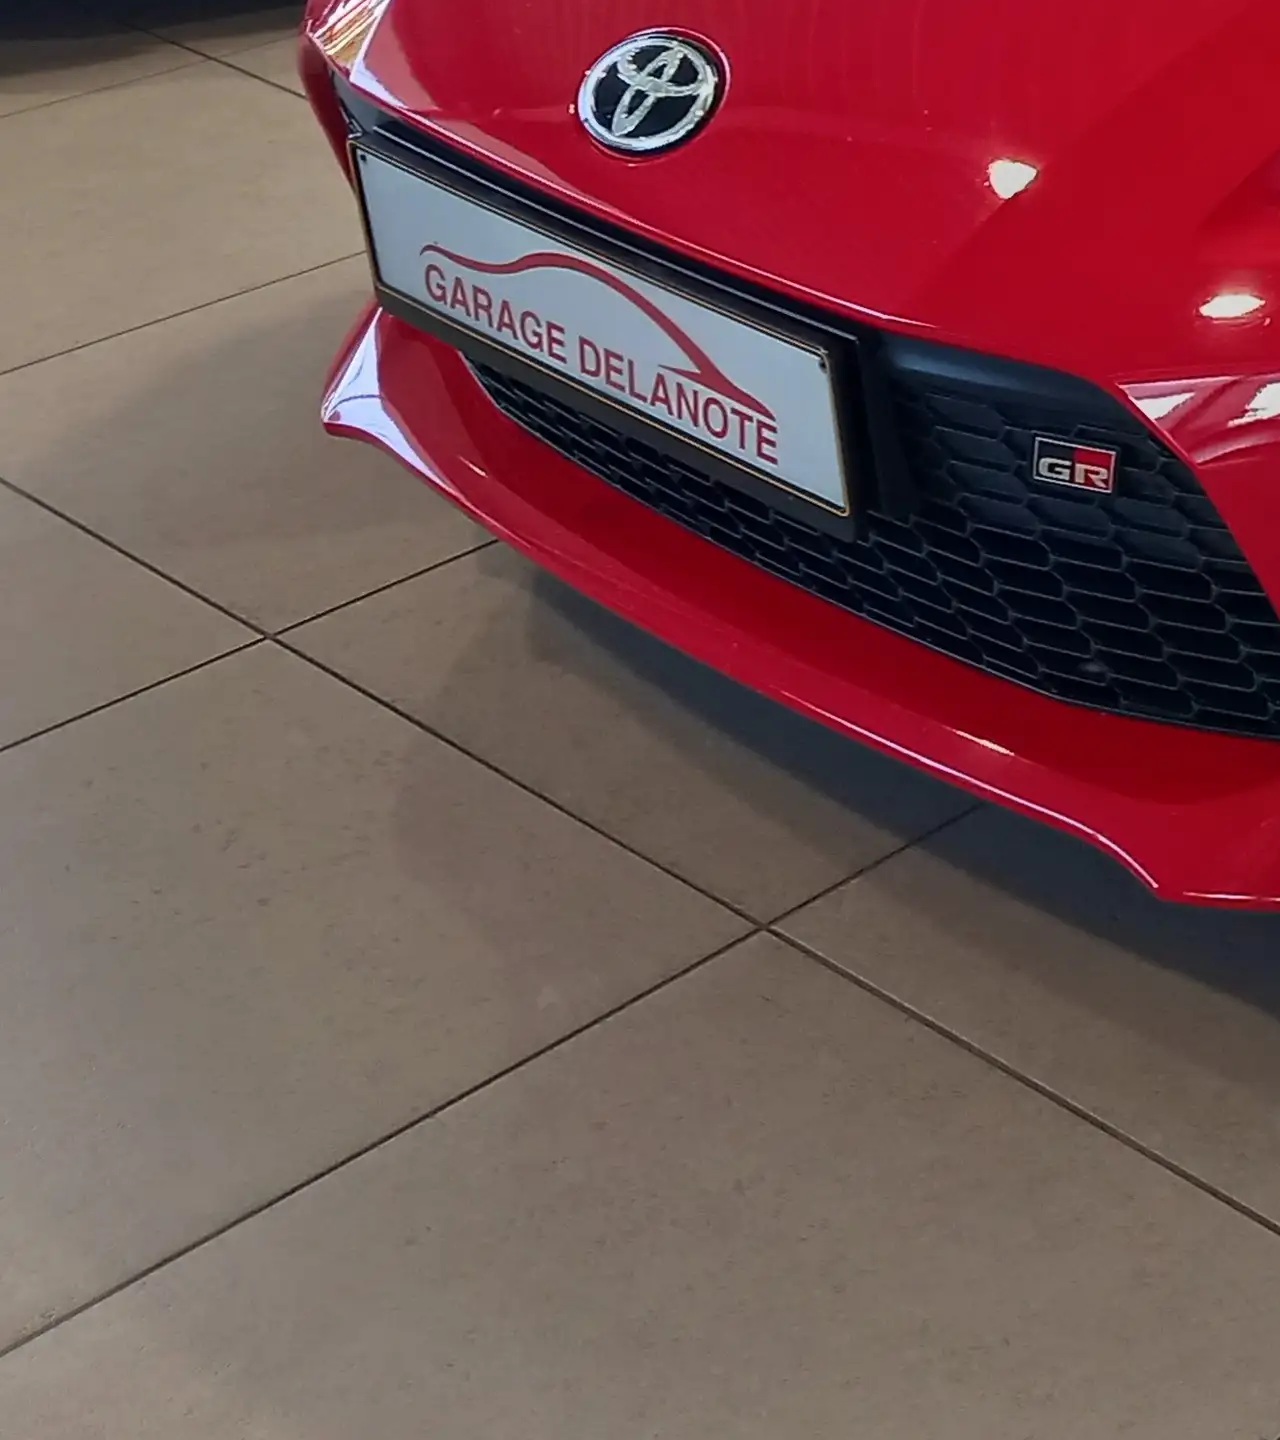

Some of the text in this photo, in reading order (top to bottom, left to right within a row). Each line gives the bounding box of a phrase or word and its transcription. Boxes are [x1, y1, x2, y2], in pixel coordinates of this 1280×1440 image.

[424, 263, 778, 465] GARAGE DELANOTE
[1038, 456, 1109, 489] GR
